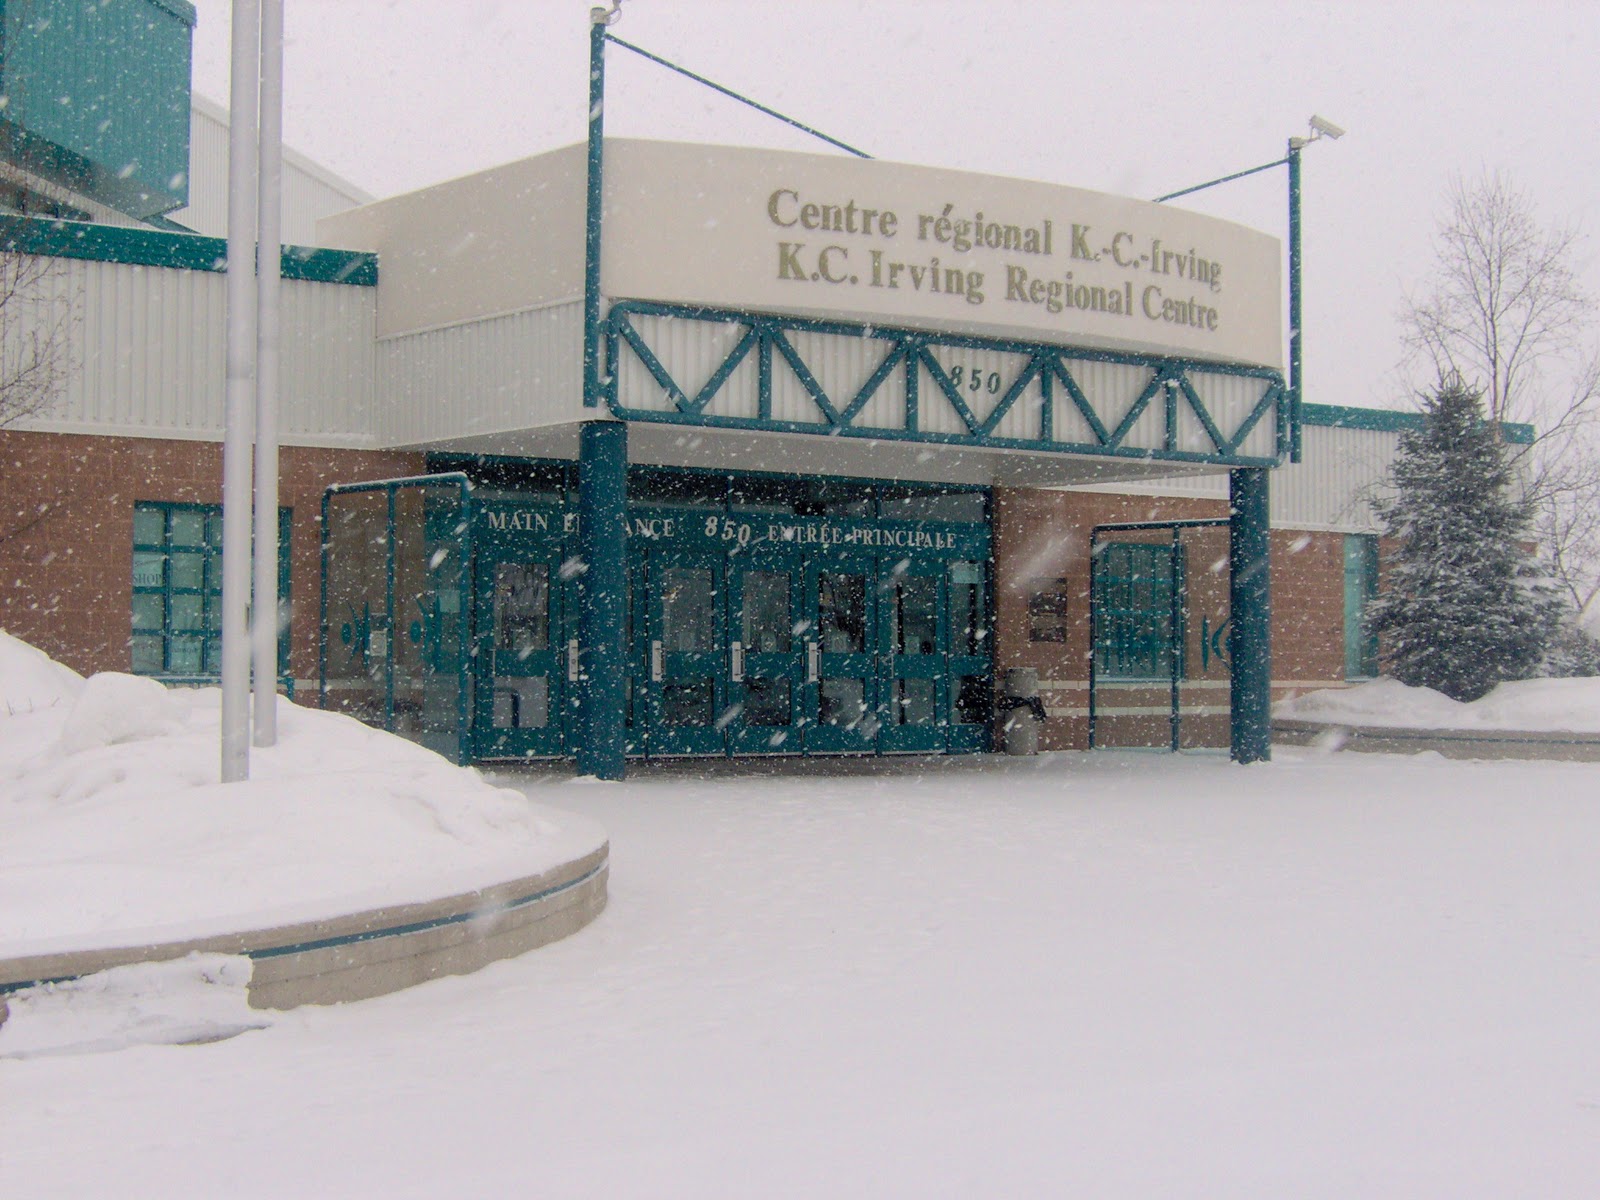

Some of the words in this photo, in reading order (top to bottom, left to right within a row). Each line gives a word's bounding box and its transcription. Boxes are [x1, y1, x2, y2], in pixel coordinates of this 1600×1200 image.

[768, 189, 898, 238] Centre
[917, 203, 1053, 255] régional
[1070, 223, 1222, 293] K.-C.-Irving
[777, 242, 859, 284] K.C.
[868, 250, 985, 305] Irving
[1004, 264, 1134, 316] Regional
[1142, 284, 1219, 332] Centre
[951, 365, 1001, 395] 850
[488, 511, 549, 531] MAIN
[704, 515, 751, 545] 850
[768, 523, 843, 544] ENTRÉE
[852, 528, 957, 548] PRINCIPALE
